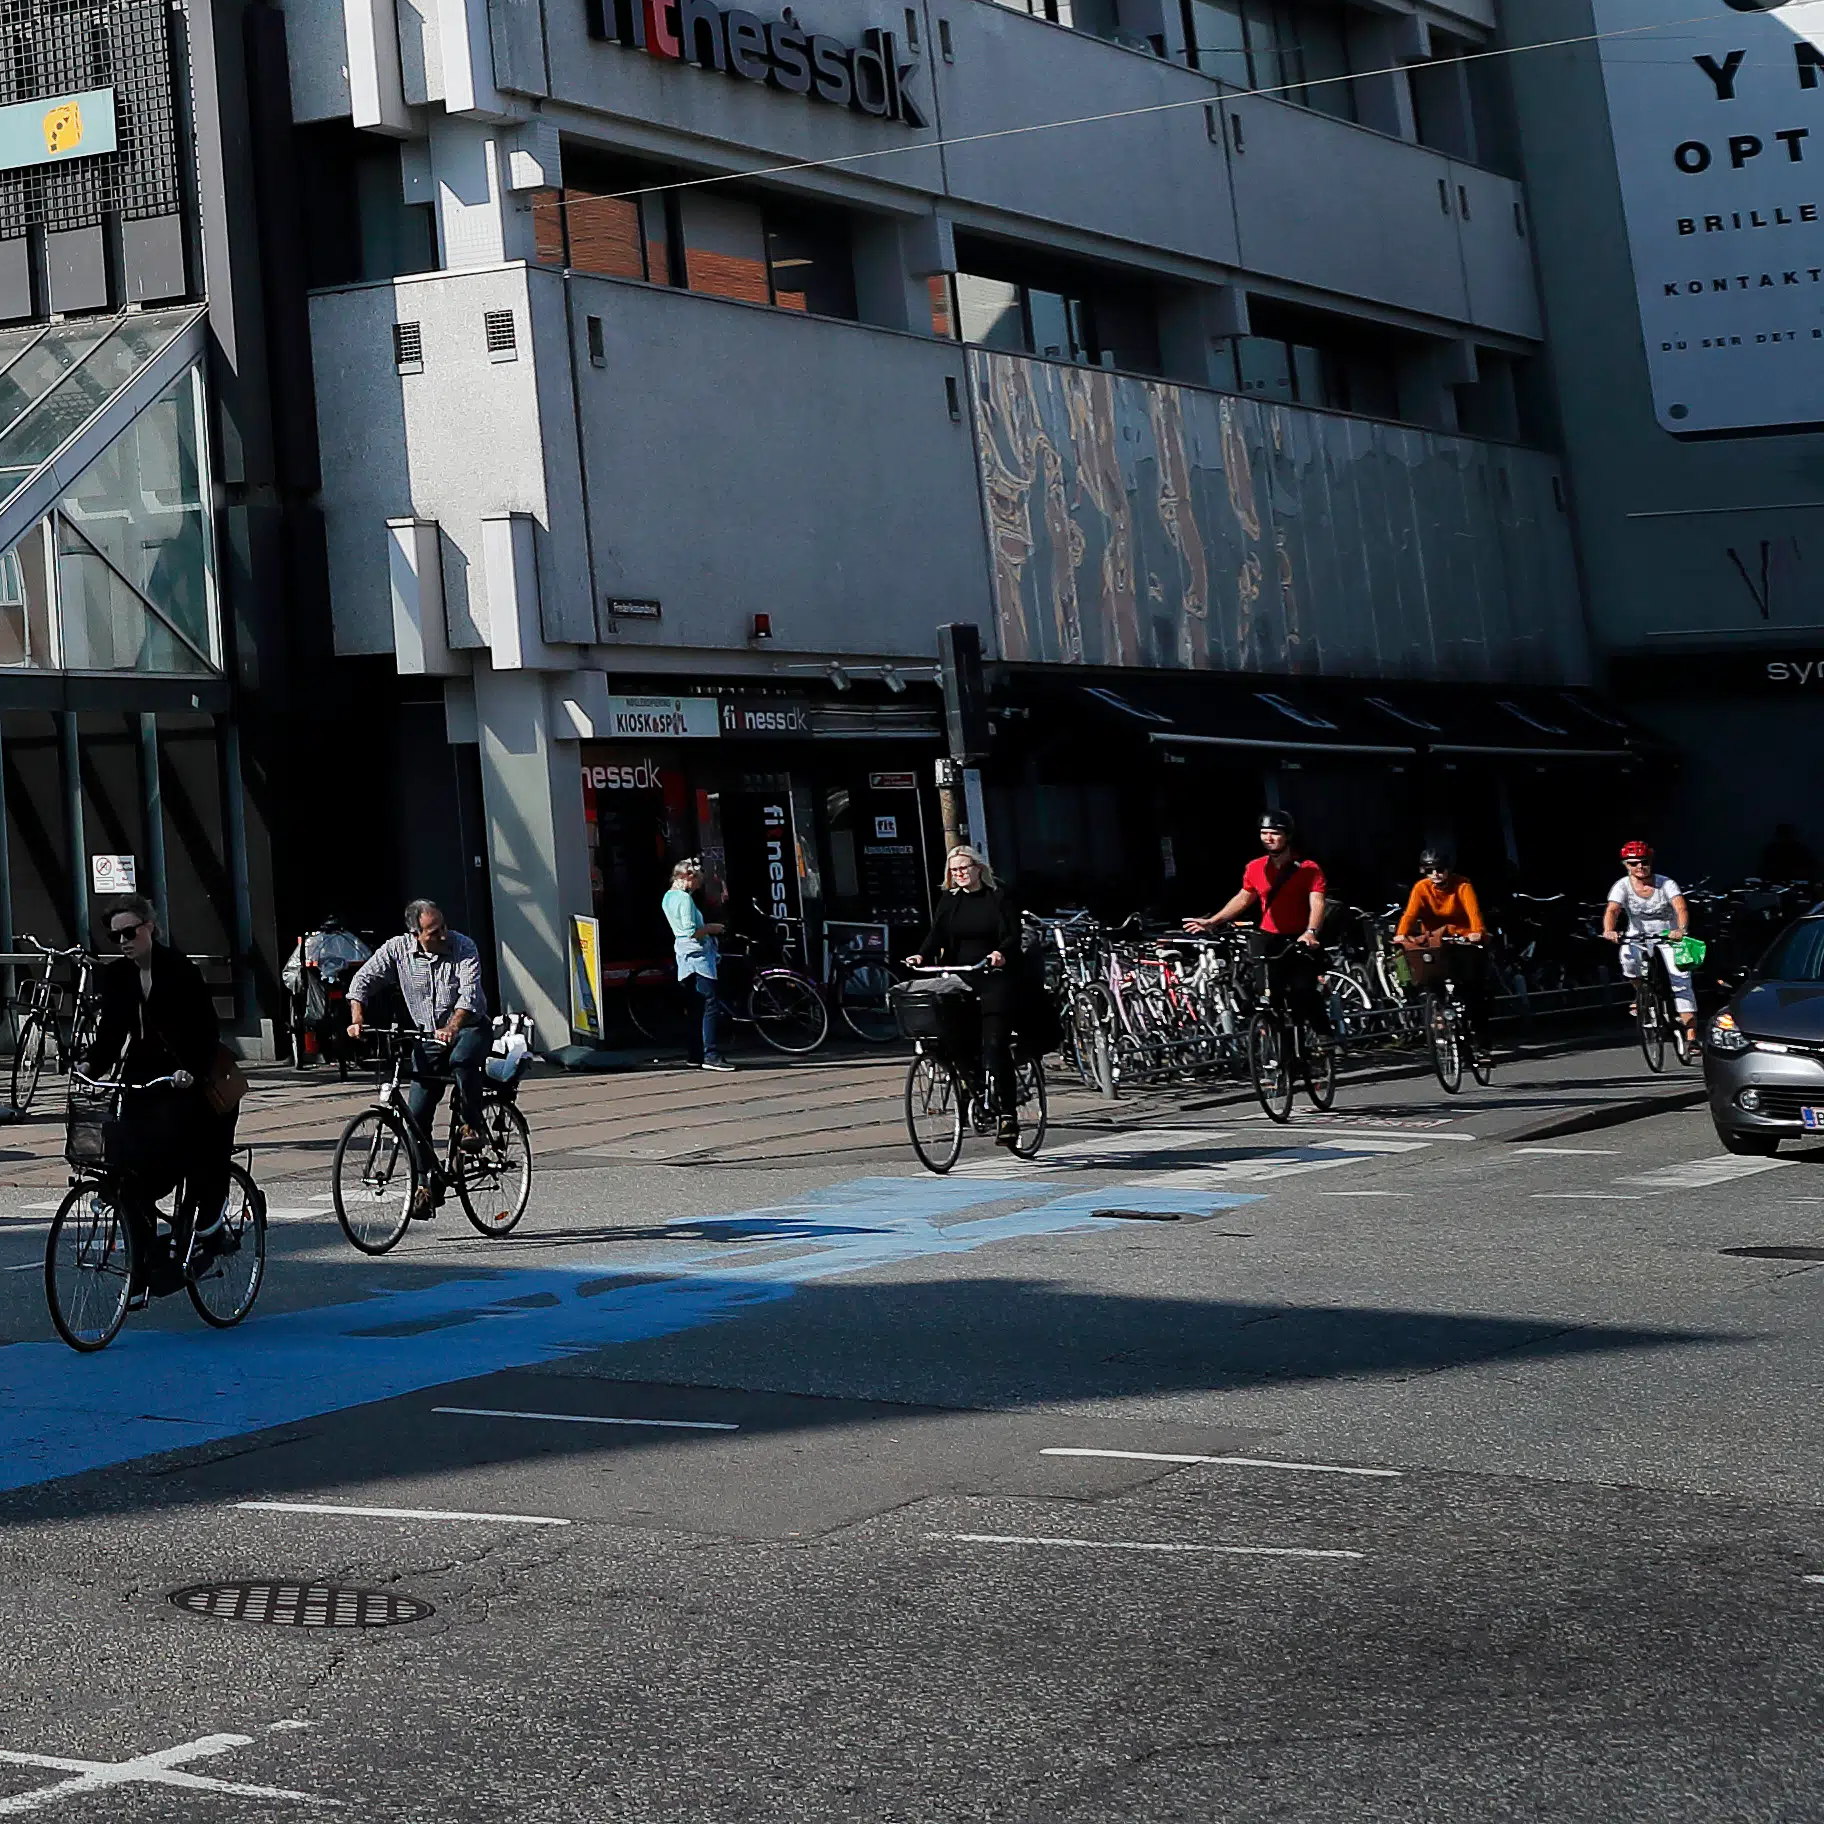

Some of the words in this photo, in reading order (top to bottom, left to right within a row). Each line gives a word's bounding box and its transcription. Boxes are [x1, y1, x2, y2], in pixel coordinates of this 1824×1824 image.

[1677, 204, 1819, 236] BRILLE
[1664, 268, 1822, 297] KONTAKT
[1661, 341, 1688, 352] DU
[1702, 336, 1742, 348] SER
[1756, 331, 1797, 344] DET
[722, 704, 809, 731] finessdk
[763, 804, 797, 966] finessdk
